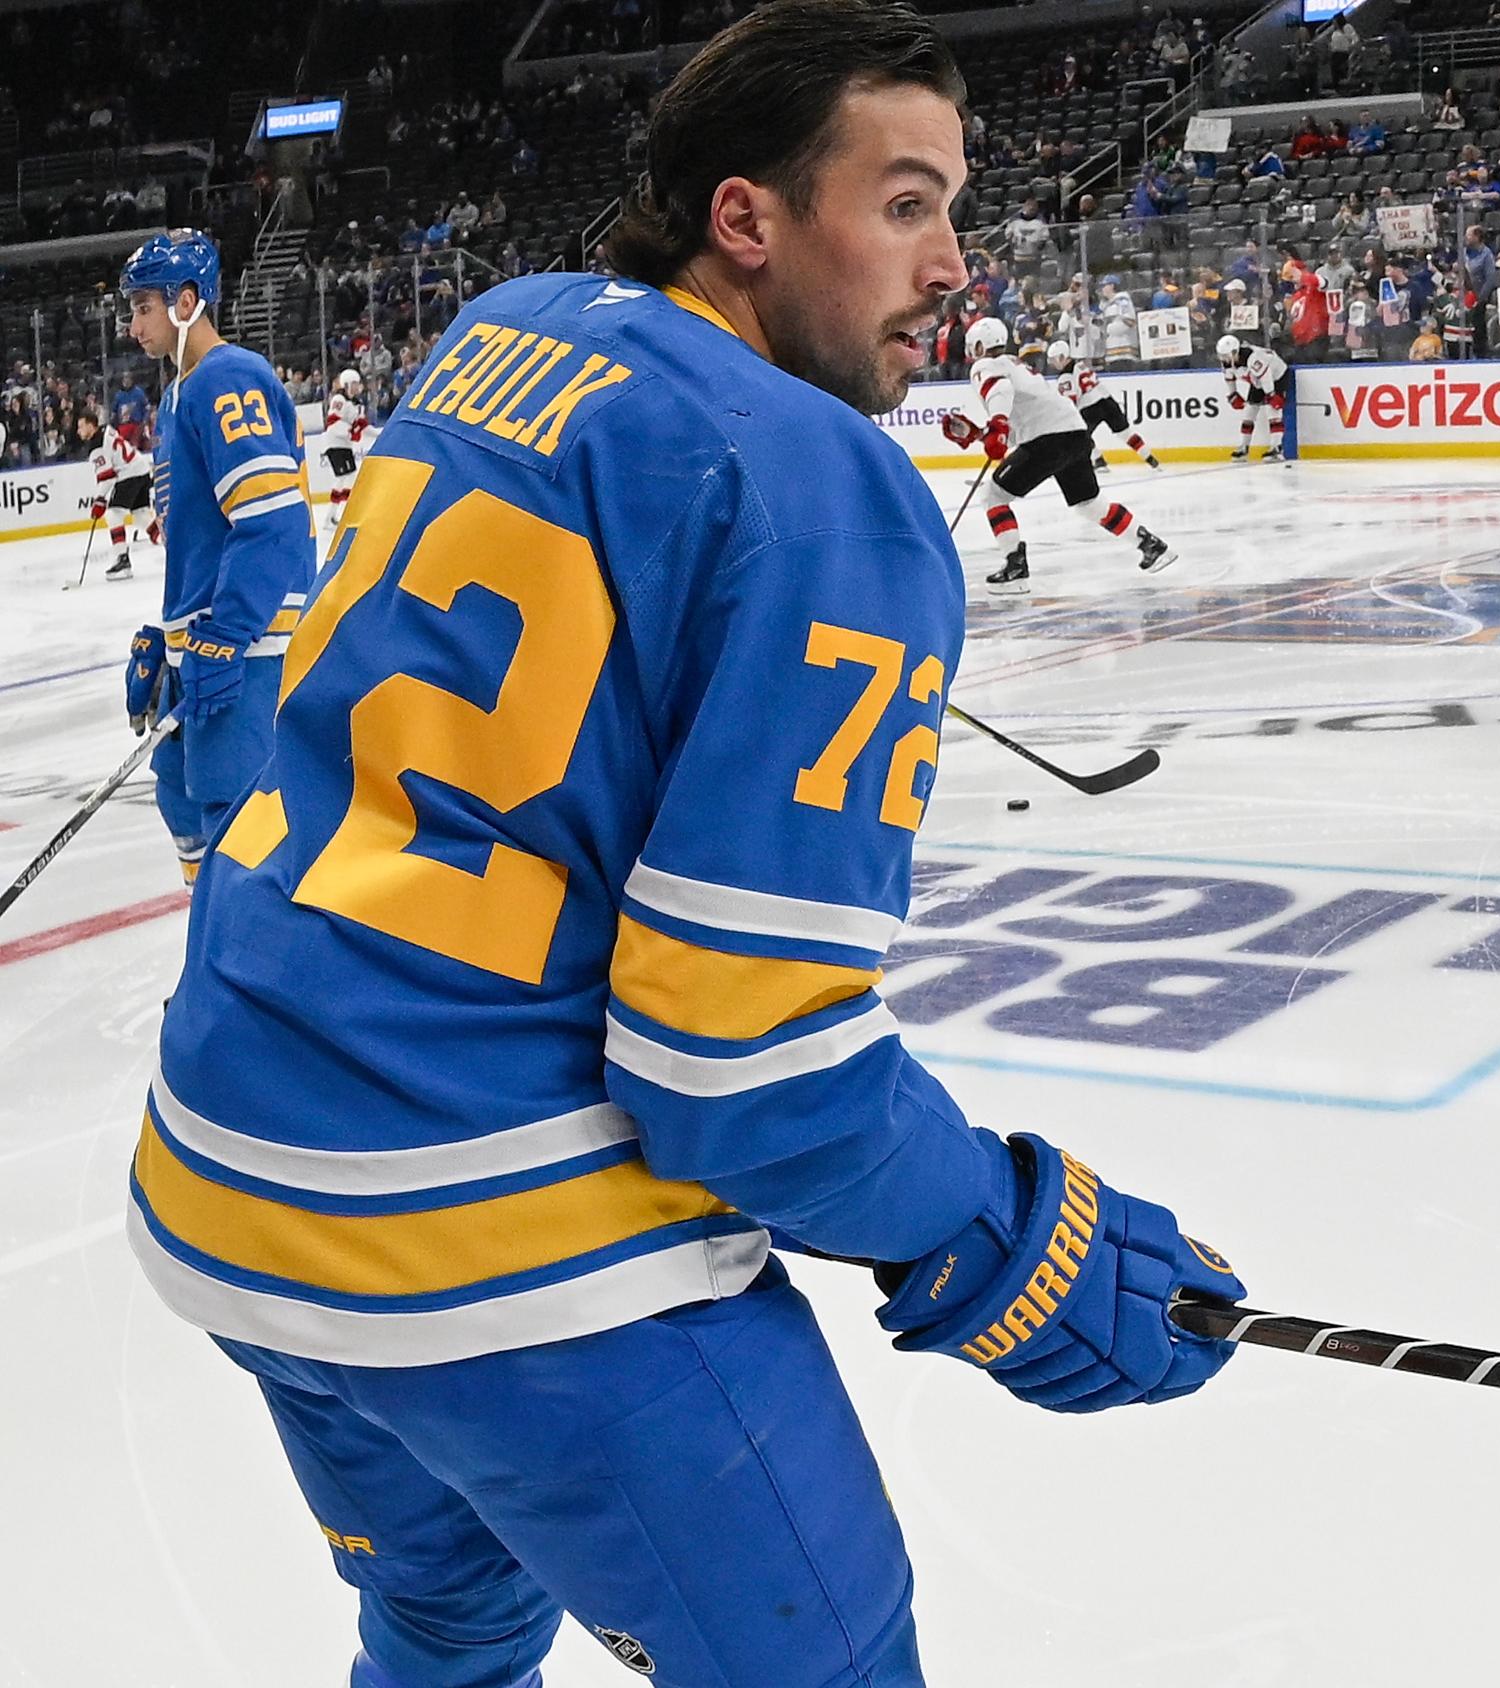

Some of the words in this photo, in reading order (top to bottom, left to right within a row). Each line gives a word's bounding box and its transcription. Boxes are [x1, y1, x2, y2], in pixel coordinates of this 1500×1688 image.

[269, 113, 298, 128] BUD
[299, 109, 337, 125] LIGHT
[214, 389, 273, 445] 23
[409, 322, 632, 456] FAULK
[1133, 390, 1219, 425] Jones
[793, 621, 946, 832] 72
[929, 1253, 957, 1300] FAULK
[960, 1148, 1103, 1364] WARRIOR
